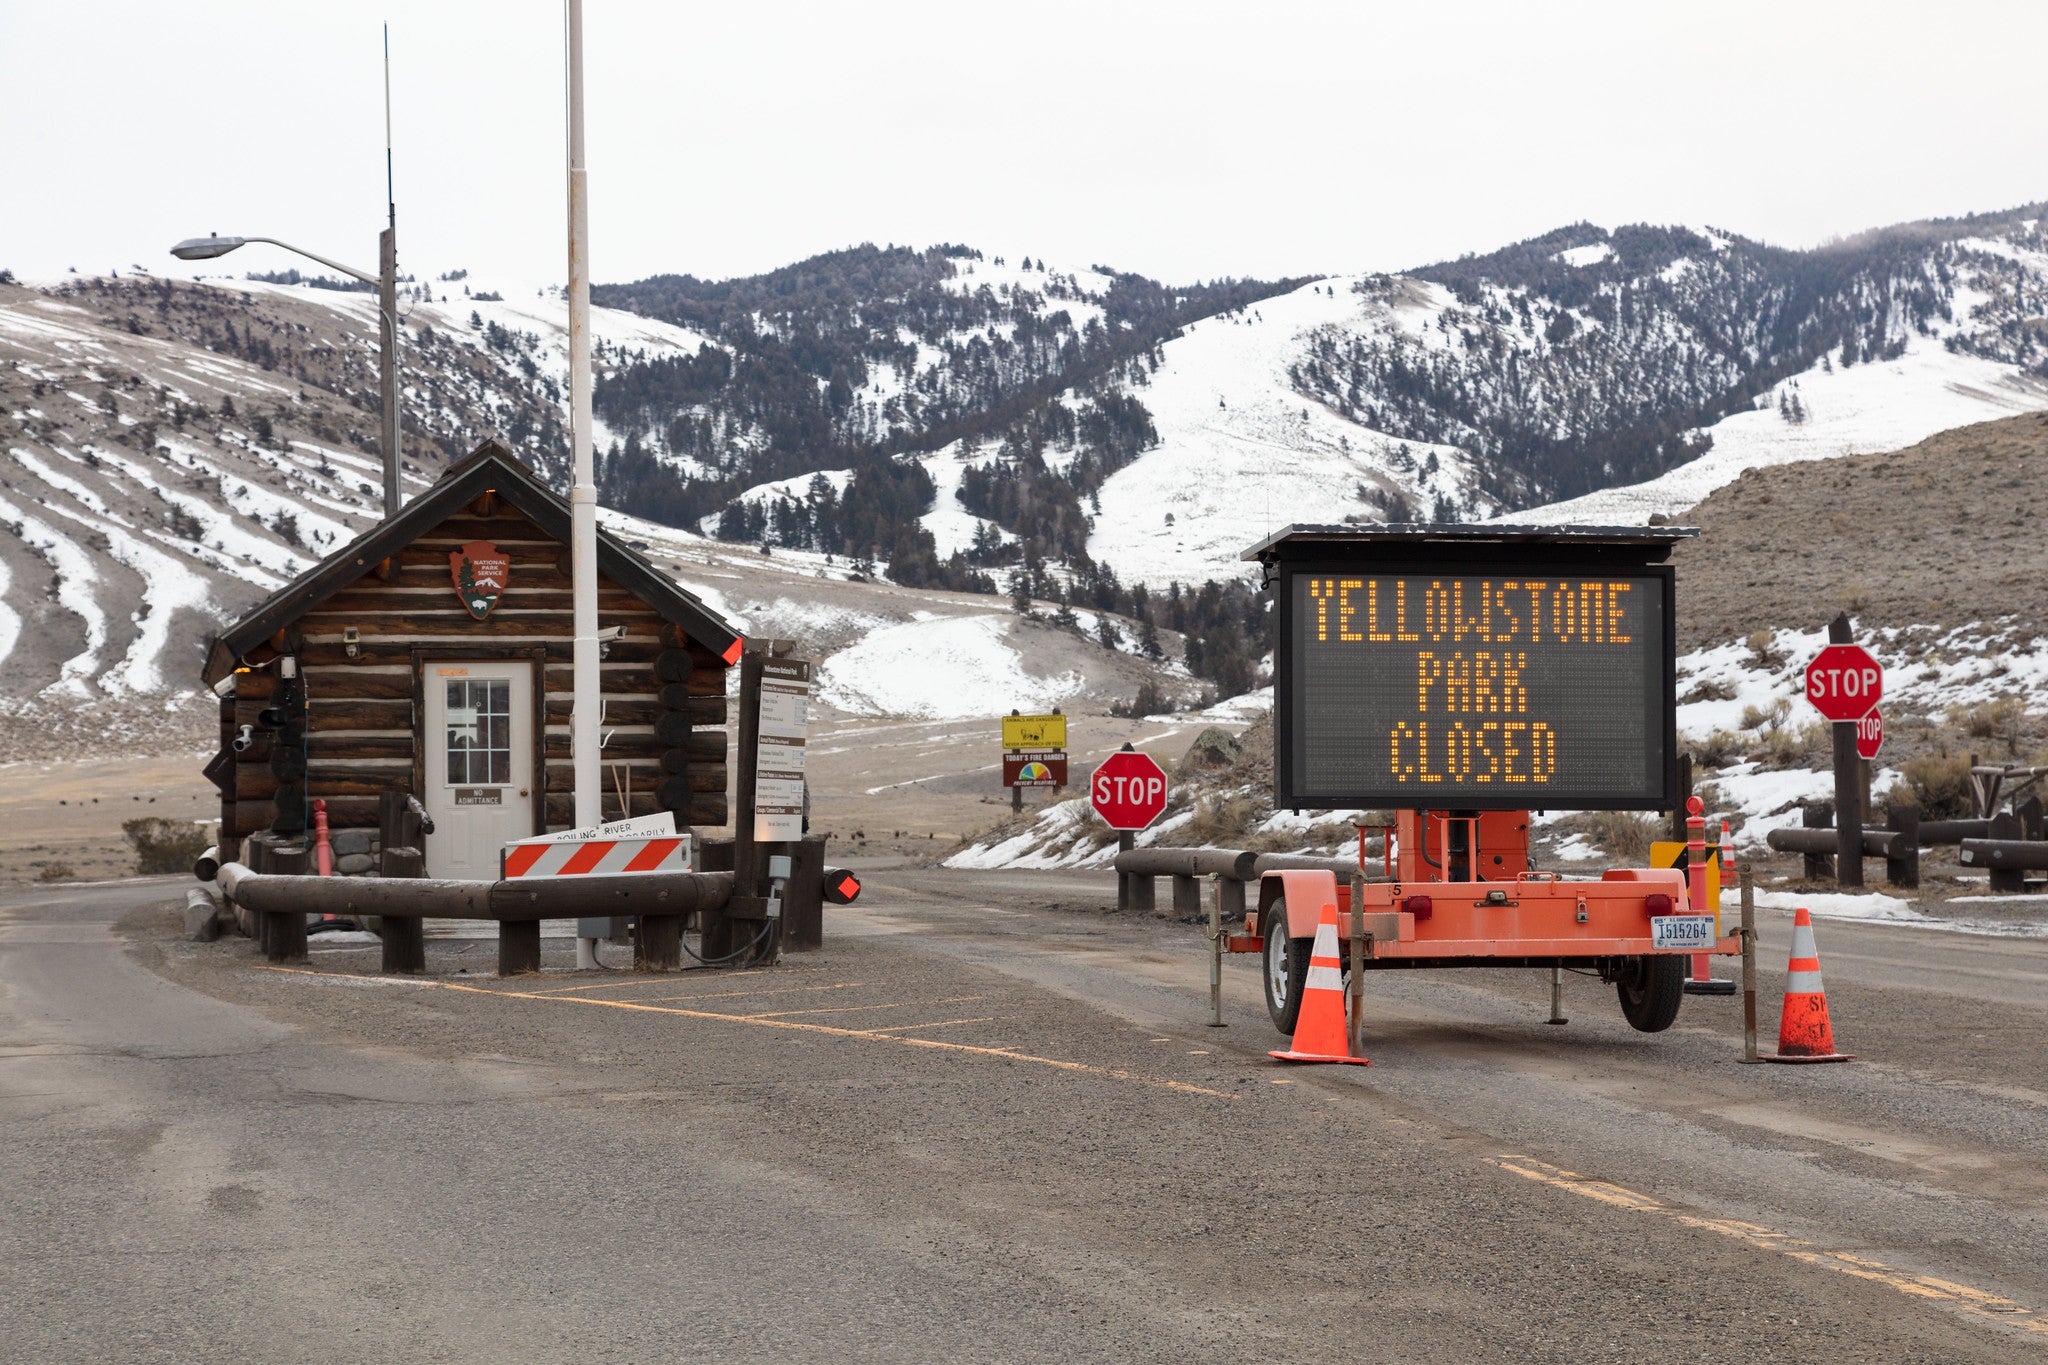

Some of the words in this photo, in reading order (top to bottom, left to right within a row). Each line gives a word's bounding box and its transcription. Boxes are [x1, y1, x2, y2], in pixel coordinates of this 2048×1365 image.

[1311, 580, 1631, 643] YELLOWSTONE
[1419, 651, 1526, 712] PARK
[1810, 668, 1877, 698] STOP
[1043, 753, 1065, 761] DANGER
[1391, 721, 1554, 782] CLOSED
[473, 789, 483, 797] NO
[1096, 776, 1162, 805] STOP
[458, 797, 499, 805] ADMITTANCE
[604, 823, 632, 836] RIVER
[1392, 884, 1401, 896] 5
[1658, 923, 1707, 939] I515264
